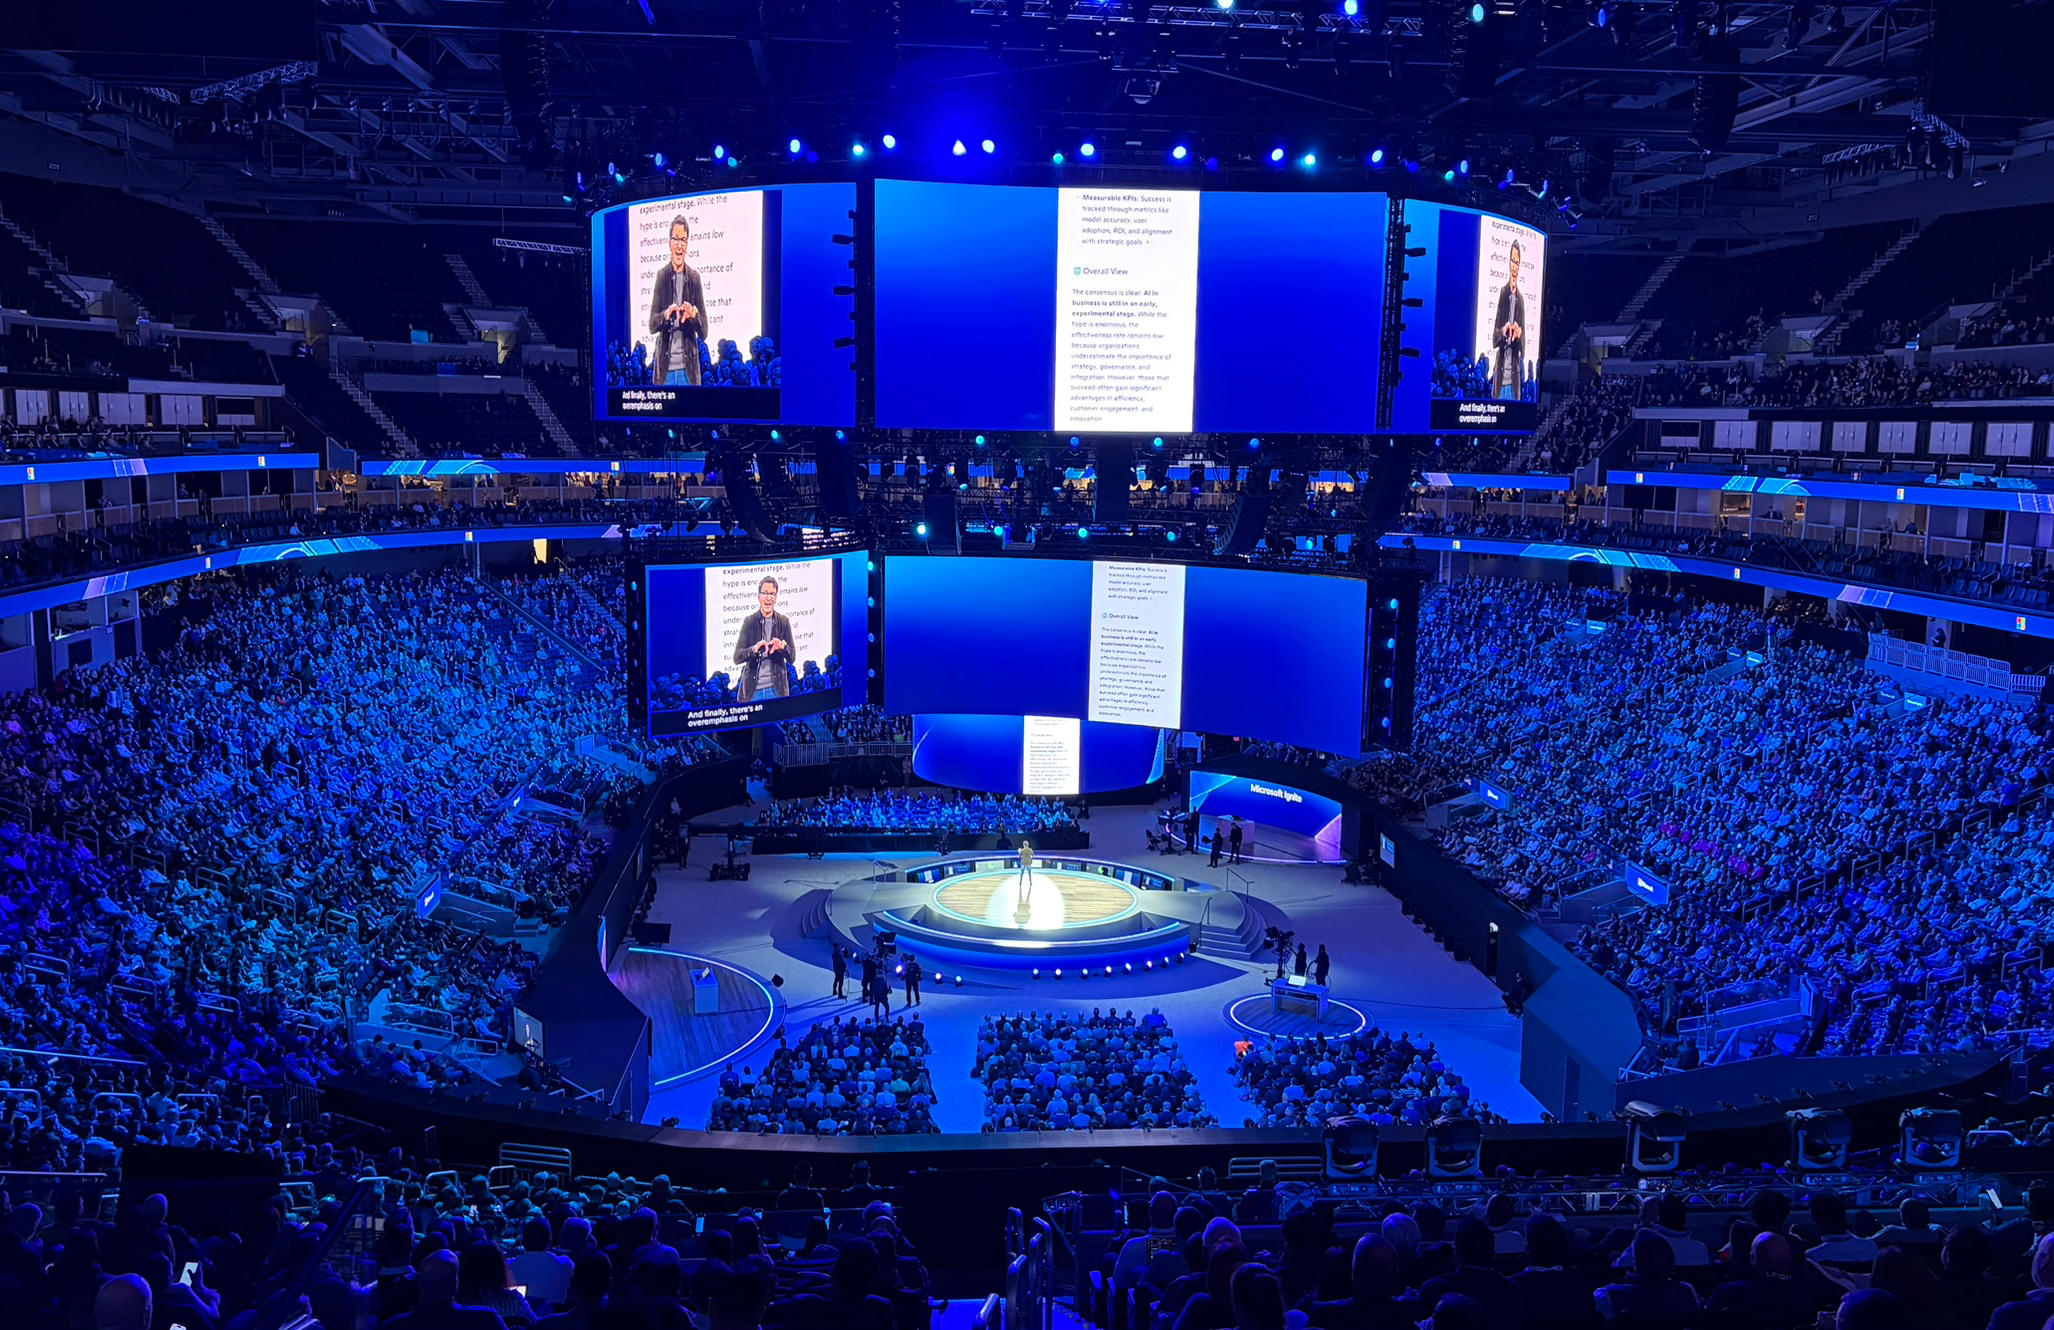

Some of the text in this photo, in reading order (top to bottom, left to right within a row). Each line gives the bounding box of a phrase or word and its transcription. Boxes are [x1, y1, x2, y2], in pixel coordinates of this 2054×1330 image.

[640, 201, 676, 215] experimental
[716, 196, 728, 204] the
[640, 222, 652, 232] hype
[690, 231, 710, 241] emains
[712, 229, 724, 238] low
[640, 254, 661, 263] because
[726, 262, 733, 272] of
[718, 297, 731, 306] that
[647, 390, 667, 400] there's
[668, 392, 676, 400] an
[1459, 402, 1471, 412] And
[1459, 414, 1491, 424] overemphasis
[722, 566, 766, 575] experimental
[779, 587, 798, 595] emains
[704, 708, 728, 717] finally,
[729, 706, 753, 714] there's
[688, 715, 738, 727] overemphasis
[1251, 783, 1302, 803] Microsoft Ignite
